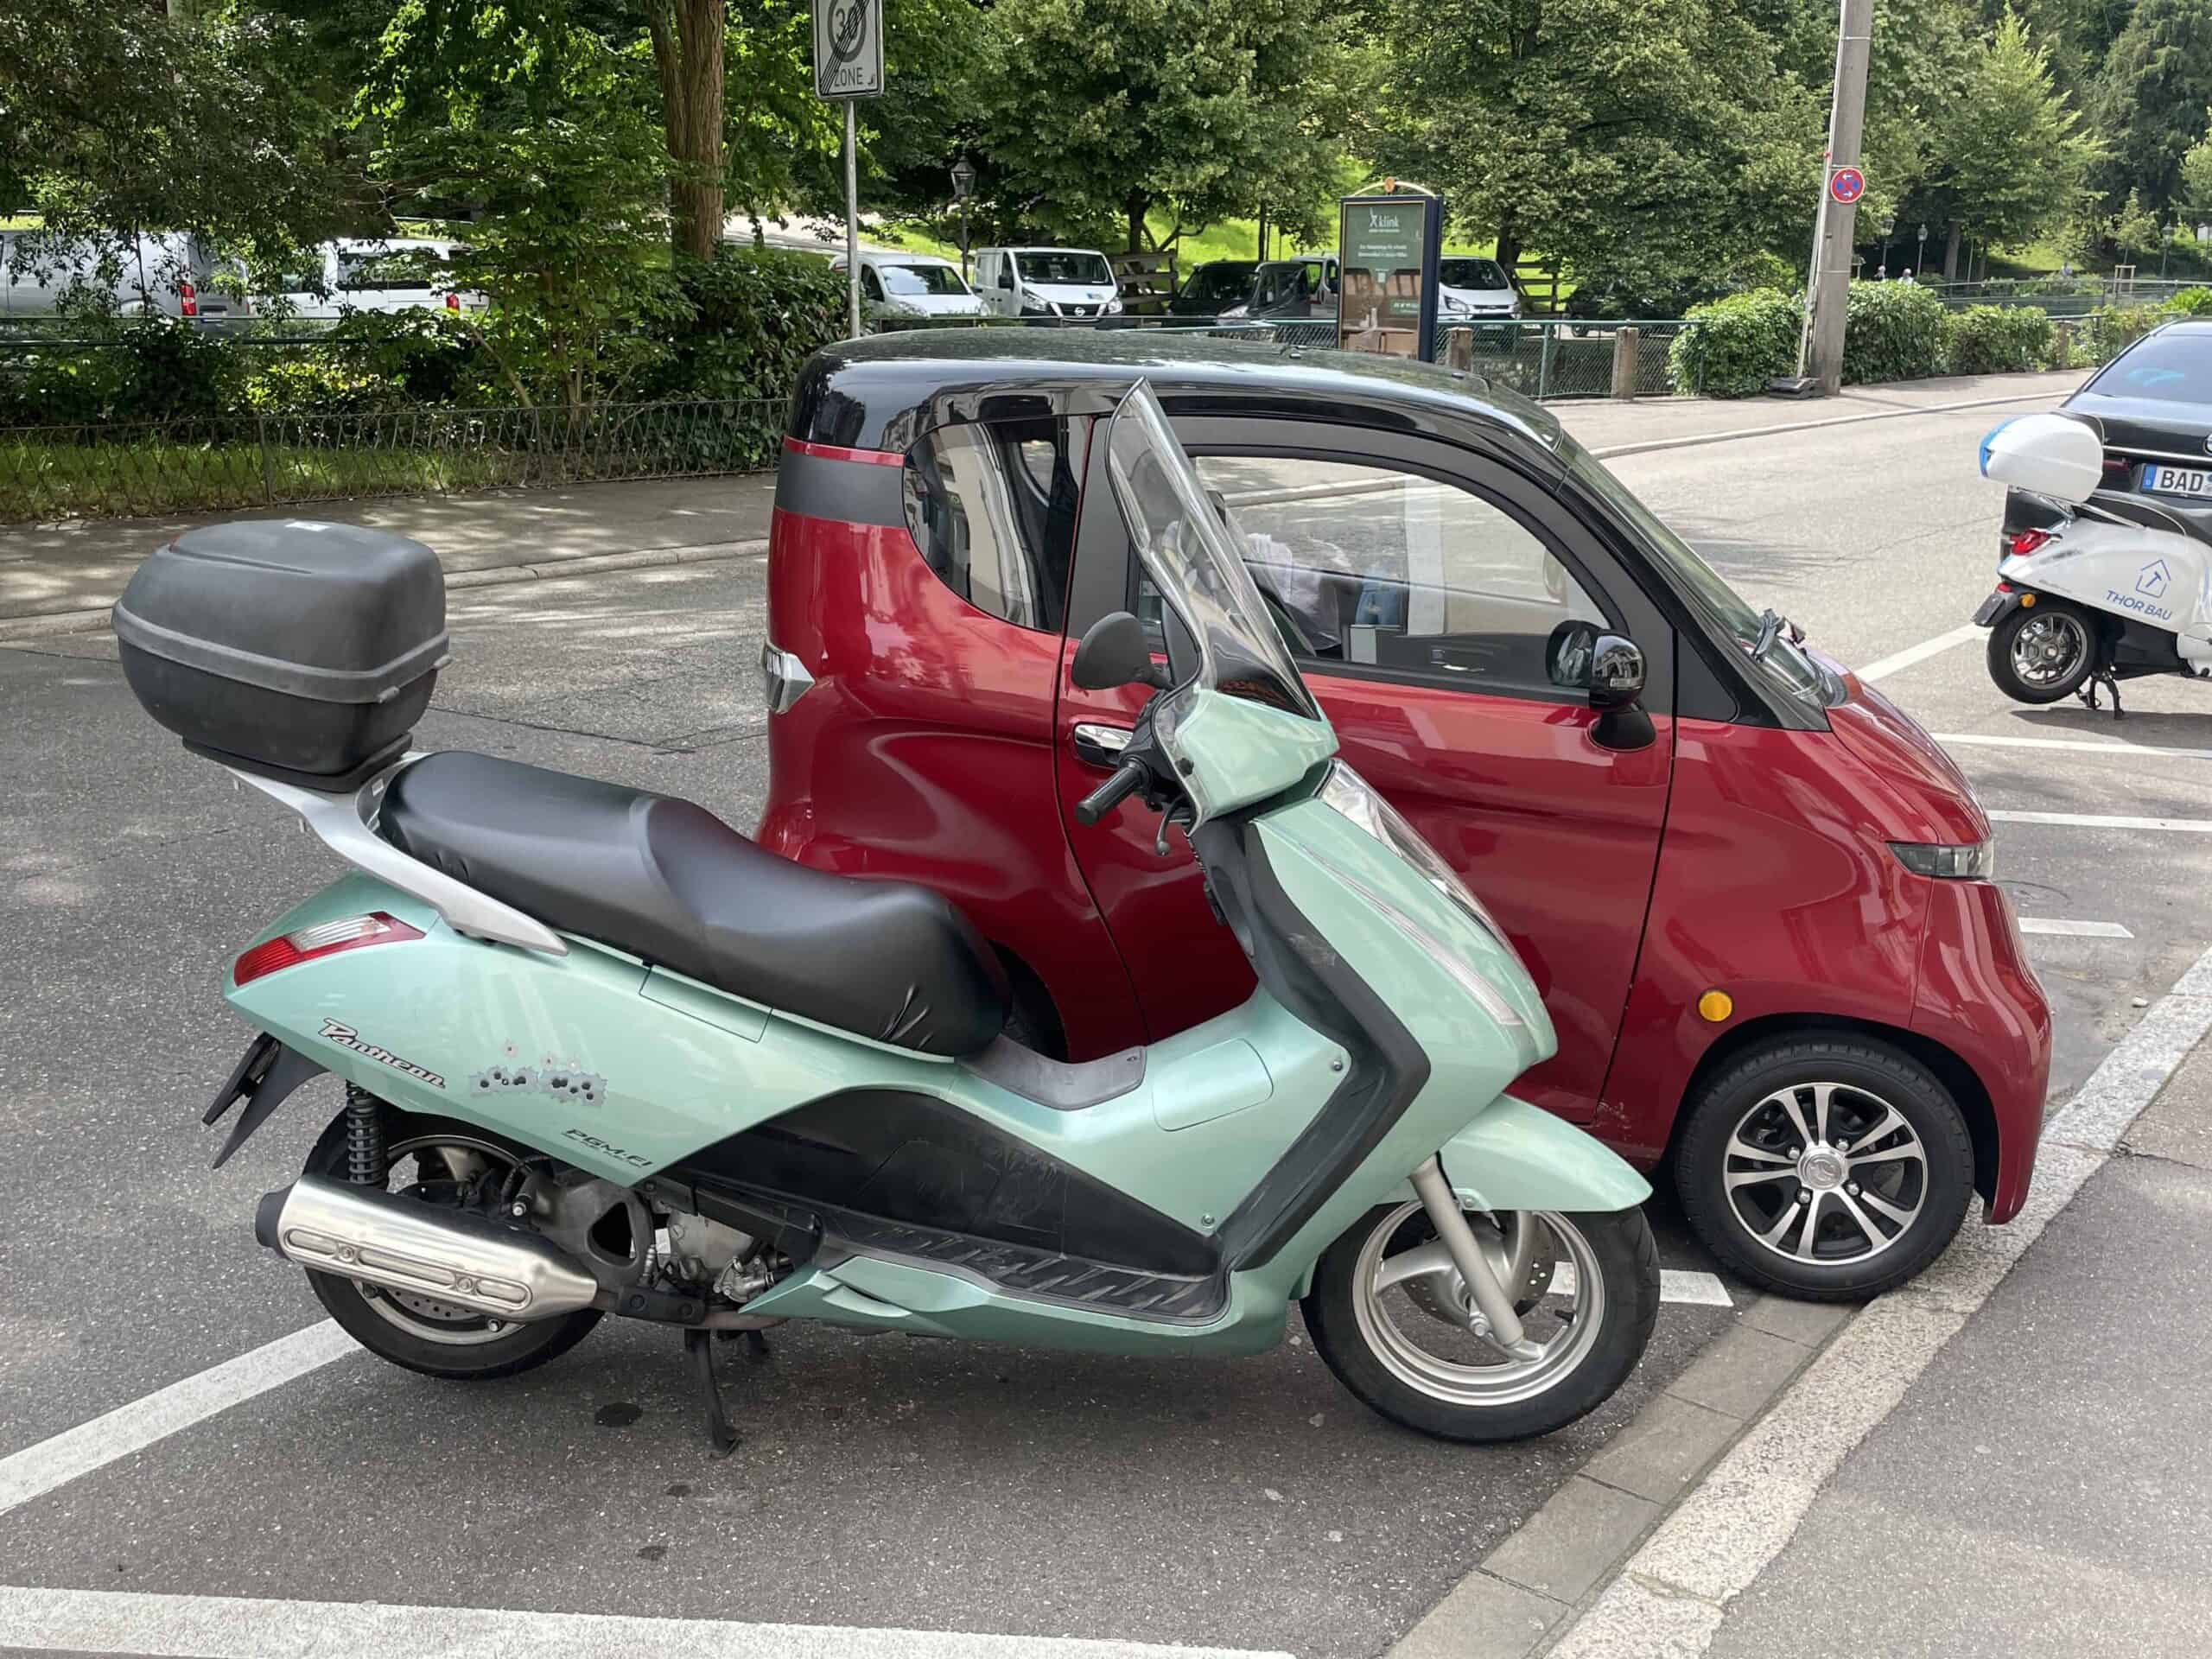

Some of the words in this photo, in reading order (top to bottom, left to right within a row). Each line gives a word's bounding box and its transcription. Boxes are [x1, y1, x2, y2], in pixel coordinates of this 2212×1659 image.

[834, 67, 864, 87] ZONE
[2160, 470, 2203, 492] BAD
[2106, 590, 2144, 611] THOR
[2144, 604, 2173, 620] BAU
[318, 1017, 446, 1089] Pantheon
